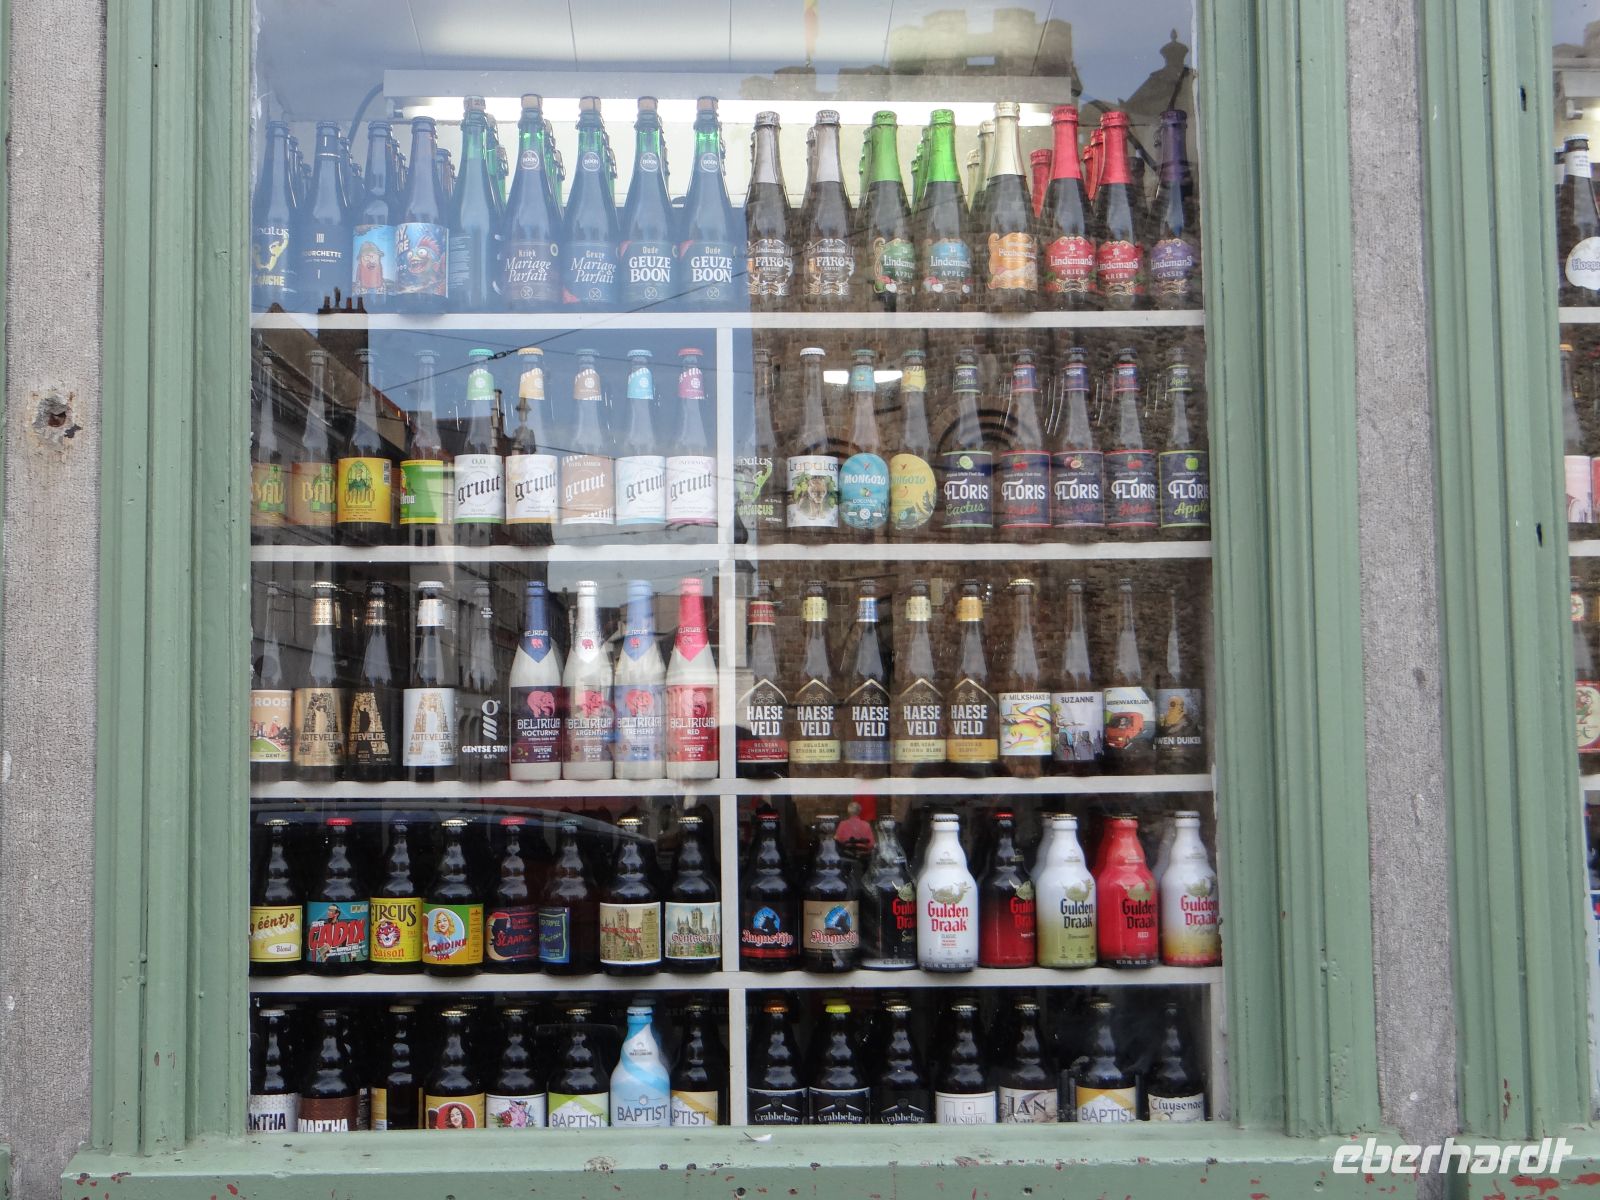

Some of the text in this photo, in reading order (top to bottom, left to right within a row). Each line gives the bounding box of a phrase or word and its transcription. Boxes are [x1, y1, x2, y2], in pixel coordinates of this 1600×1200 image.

[629, 256, 672, 269] GEUZE
[691, 256, 733, 269] GEUZE
[755, 256, 784, 268] FARO
[816, 256, 845, 268] FARO
[630, 268, 671, 283] BOON
[692, 268, 732, 284] BOON
[565, 471, 606, 504] gruut
[670, 470, 712, 503] gruut
[844, 474, 887, 487] MONGOZO
[457, 474, 501, 505] gruut
[944, 479, 989, 501] FLORIS
[1001, 479, 1046, 501] FLORIS
[1055, 478, 1099, 501] FLORIS
[1112, 477, 1156, 500] FLORIS
[946, 501, 986, 517] Cactus
[1060, 695, 1095, 704] SUZANNE
[746, 705, 783, 720] HAESE
[797, 705, 834, 721] HAESE
[852, 706, 889, 721] HAESE
[903, 705, 941, 720] HAESE
[951, 704, 988, 720] HAESE
[521, 729, 560, 737] NOCTURNUM
[687, 728, 700, 736] RED
[750, 721, 781, 736] VELD
[800, 721, 831, 737] VELD
[855, 721, 886, 737] VELD
[906, 720, 937, 736] VELD
[953, 720, 984, 736] VELD
[411, 732, 451, 742] ARTEVELDE
[462, 744, 492, 754] GENTSE
[927, 901, 969, 918] Gulden
[1060, 899, 1094, 916] Gulden
[931, 917, 968, 932] Draak
[1063, 915, 1094, 929] Draak
[309, 919, 366, 950] CADIX
[373, 944, 405, 959] Saison
[1005, 1094, 1047, 1116] JAN
[552, 1113, 604, 1128] BAPTIST
[617, 1104, 667, 1122] BAPTIST
[754, 1111, 799, 1124] Crabbelaer
[818, 1111, 863, 1123] Crabbelaer
[1081, 1107, 1135, 1123] BAPTIST
